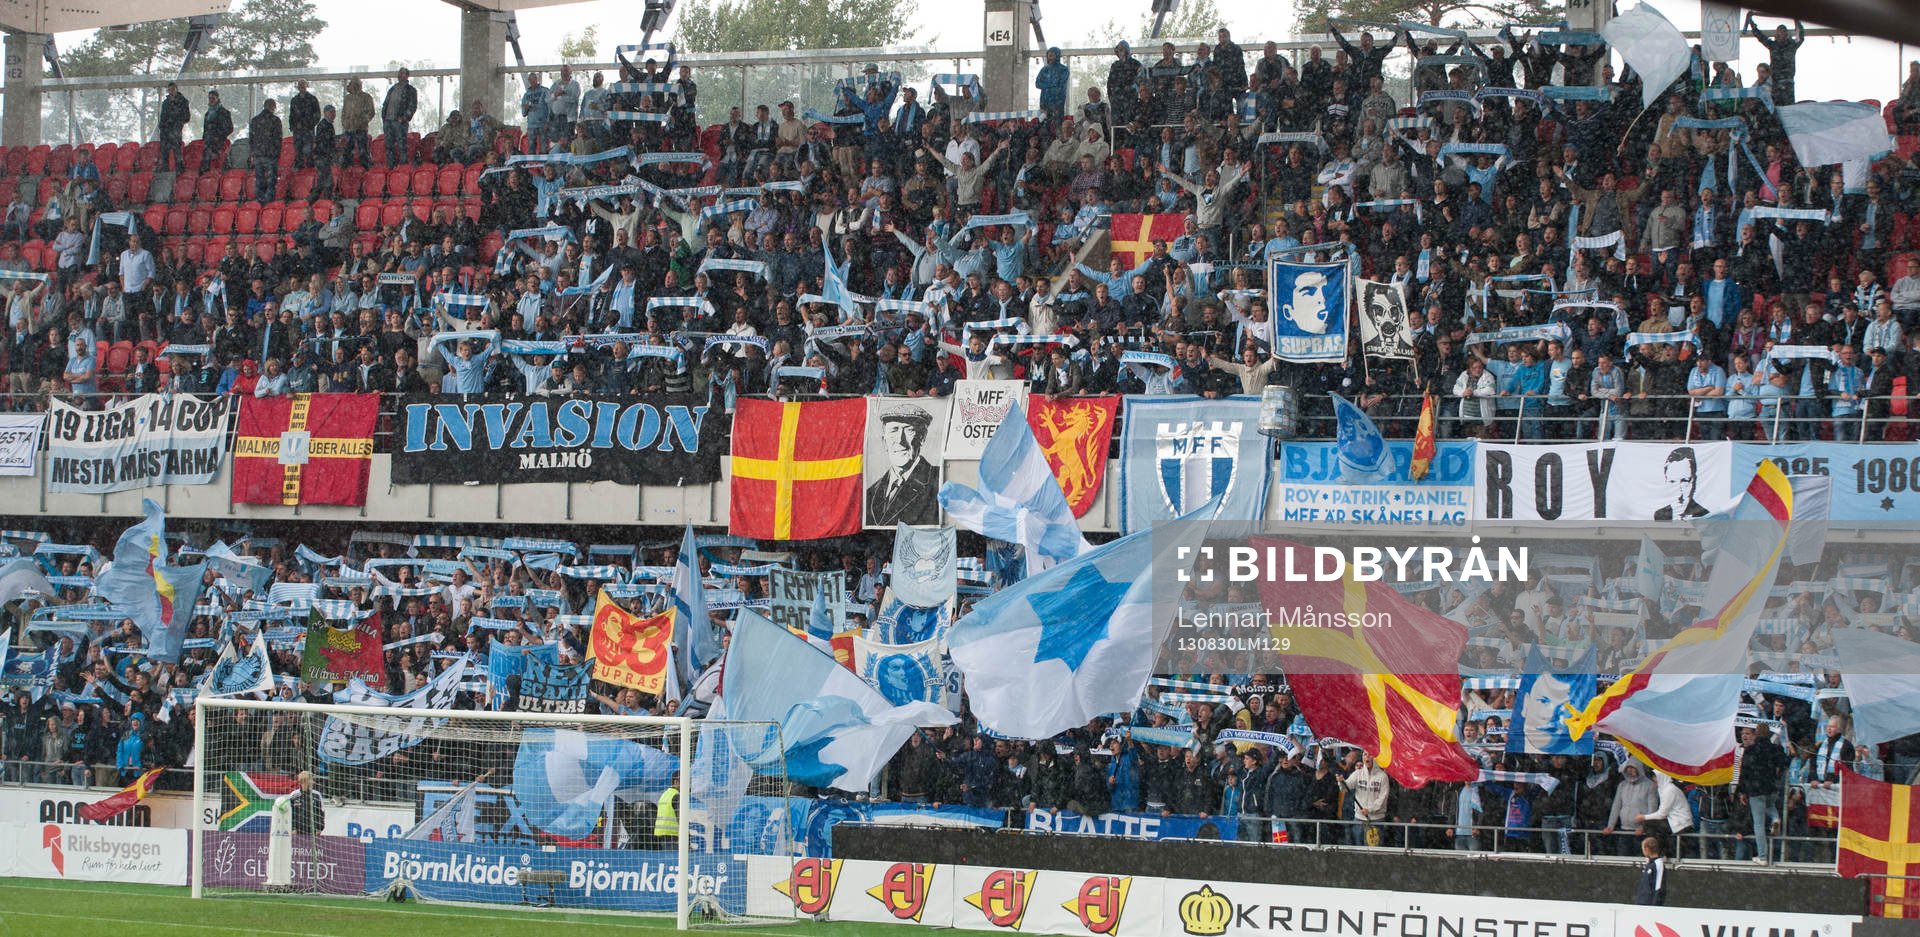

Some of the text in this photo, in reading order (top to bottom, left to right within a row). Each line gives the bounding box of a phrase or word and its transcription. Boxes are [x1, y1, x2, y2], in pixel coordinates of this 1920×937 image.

[994, 31, 1011, 42] E4
[1281, 336, 1345, 353] SUPRAS
[977, 390, 1005, 405] MFF
[54, 400, 226, 442] 19 LIGA 14 CUP
[404, 400, 709, 453] INVASION
[963, 421, 1000, 439] ÖSTE
[309, 438, 337, 455] ÜBER
[340, 443, 372, 456] ALLES
[1172, 436, 1223, 456] MFF
[53, 447, 218, 485] MESTA MÄSTARNA
[519, 449, 592, 470] MALMÖ
[1285, 447, 1470, 482] BJRD
[1486, 449, 1616, 521] ROY
[1285, 488, 1467, 506] ROY PATRIK DANIEL
[1285, 506, 1465, 527] MFF ÄR SKÅNES LAG
[308, 666, 339, 680] Ultras
[521, 655, 595, 688] REX
[593, 663, 658, 690] SUPRAS
[520, 681, 588, 699] SCANIA
[518, 696, 586, 713] ULTRAS
[1029, 808, 1162, 839] BLATTE
[67, 836, 161, 860] Riksbyggen
[257, 846, 323, 858] ADFIRMN
[244, 860, 337, 881] GLSTEDT
[383, 850, 531, 886] Björnkläde
